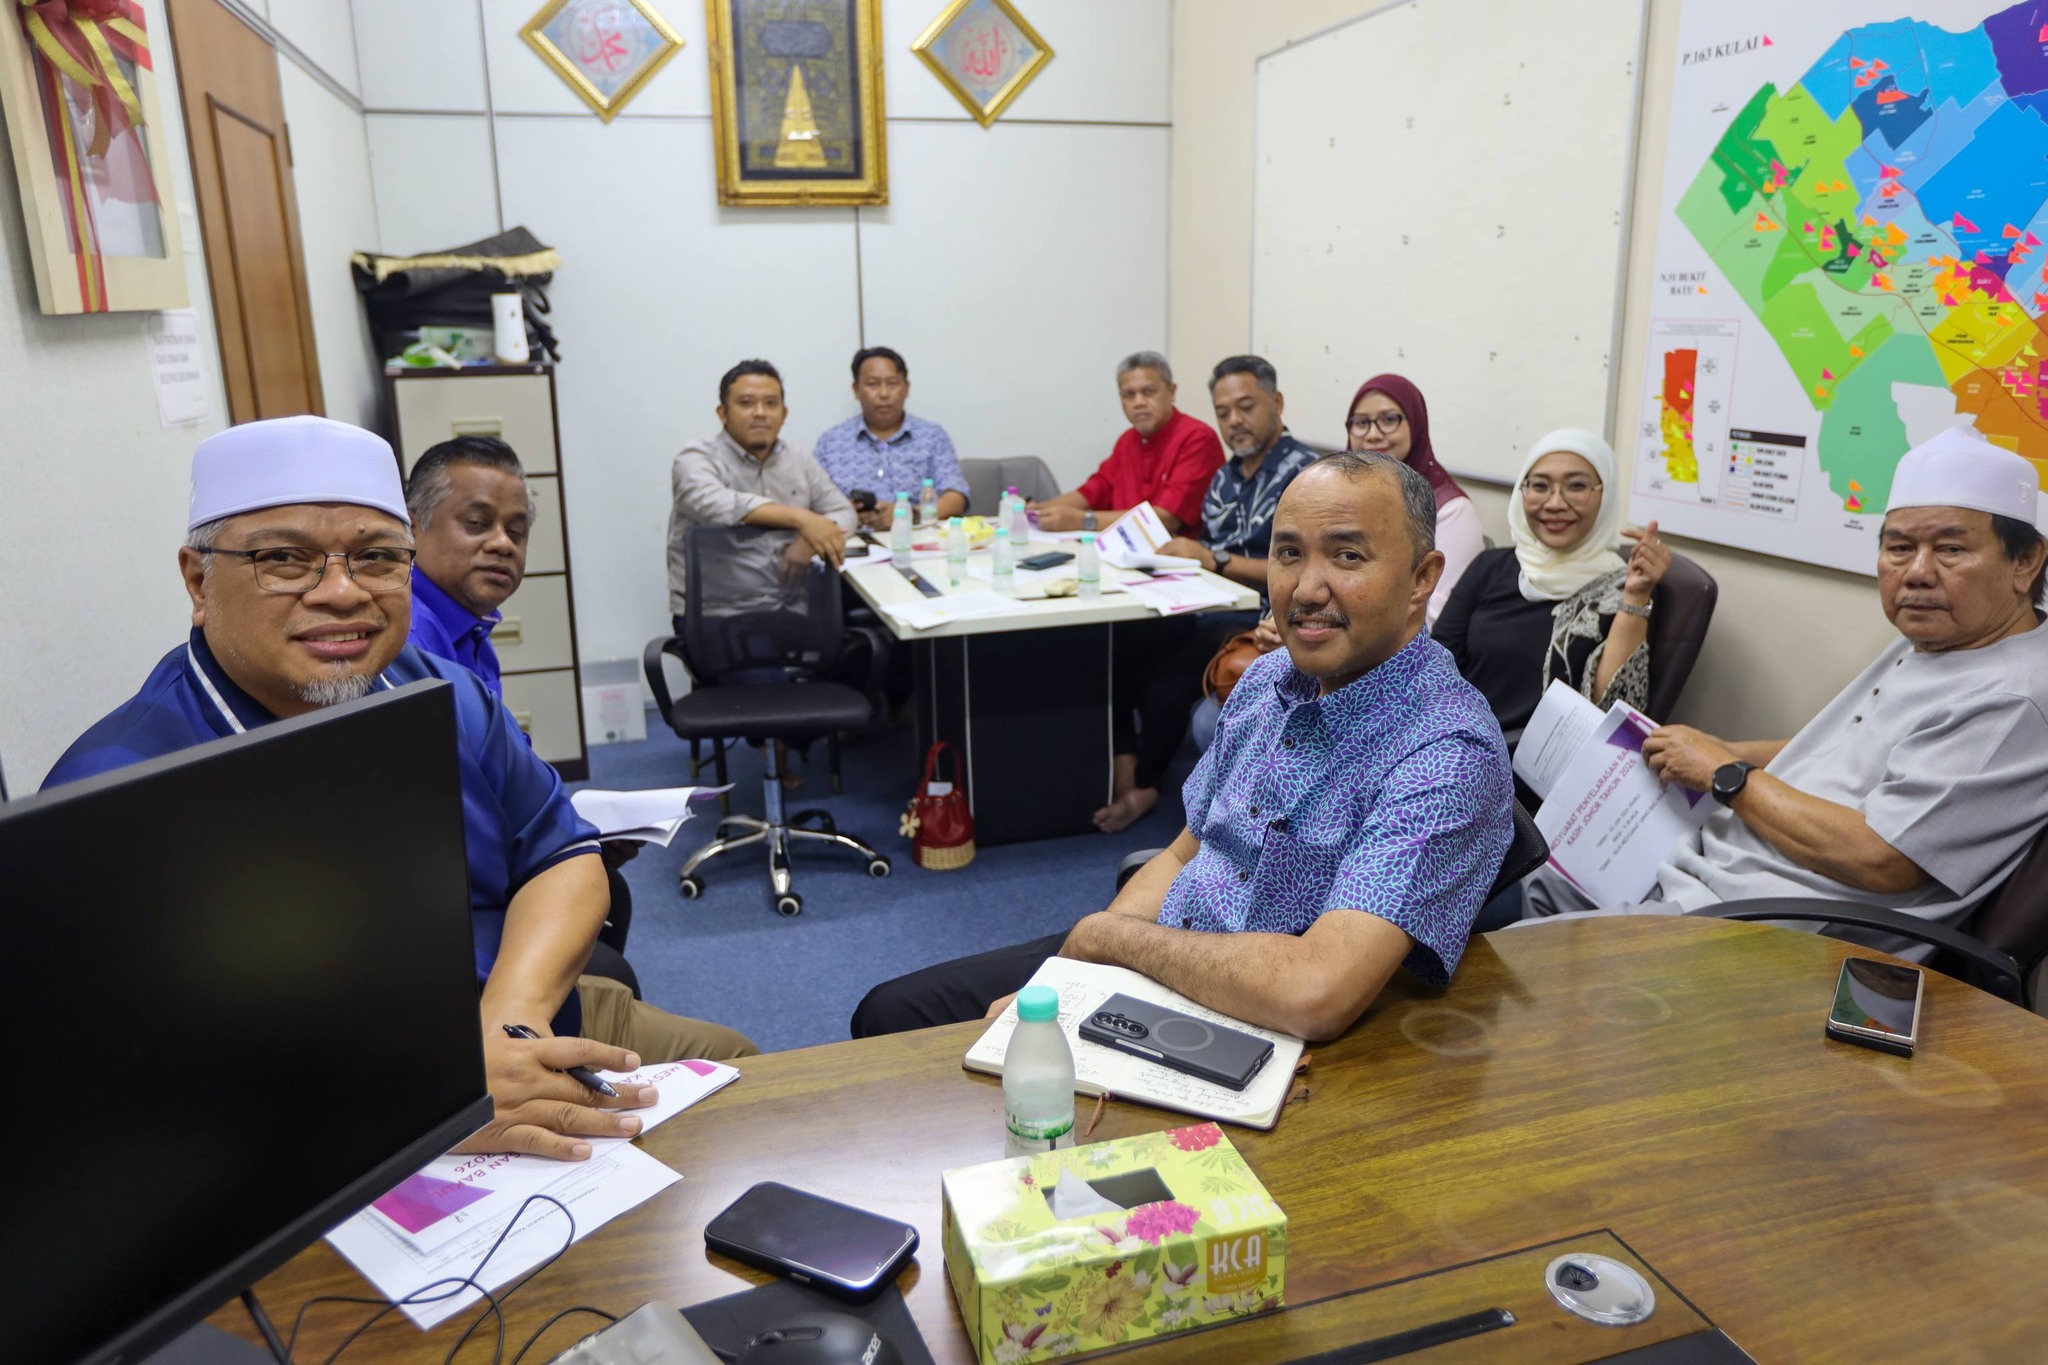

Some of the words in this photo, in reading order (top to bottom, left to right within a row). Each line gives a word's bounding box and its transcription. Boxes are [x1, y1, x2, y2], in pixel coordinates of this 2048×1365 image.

[1714, 36, 1758, 59] KULAI
[1208, 1234, 1261, 1276] KCA
[861, 1332, 882, 1365] acer
